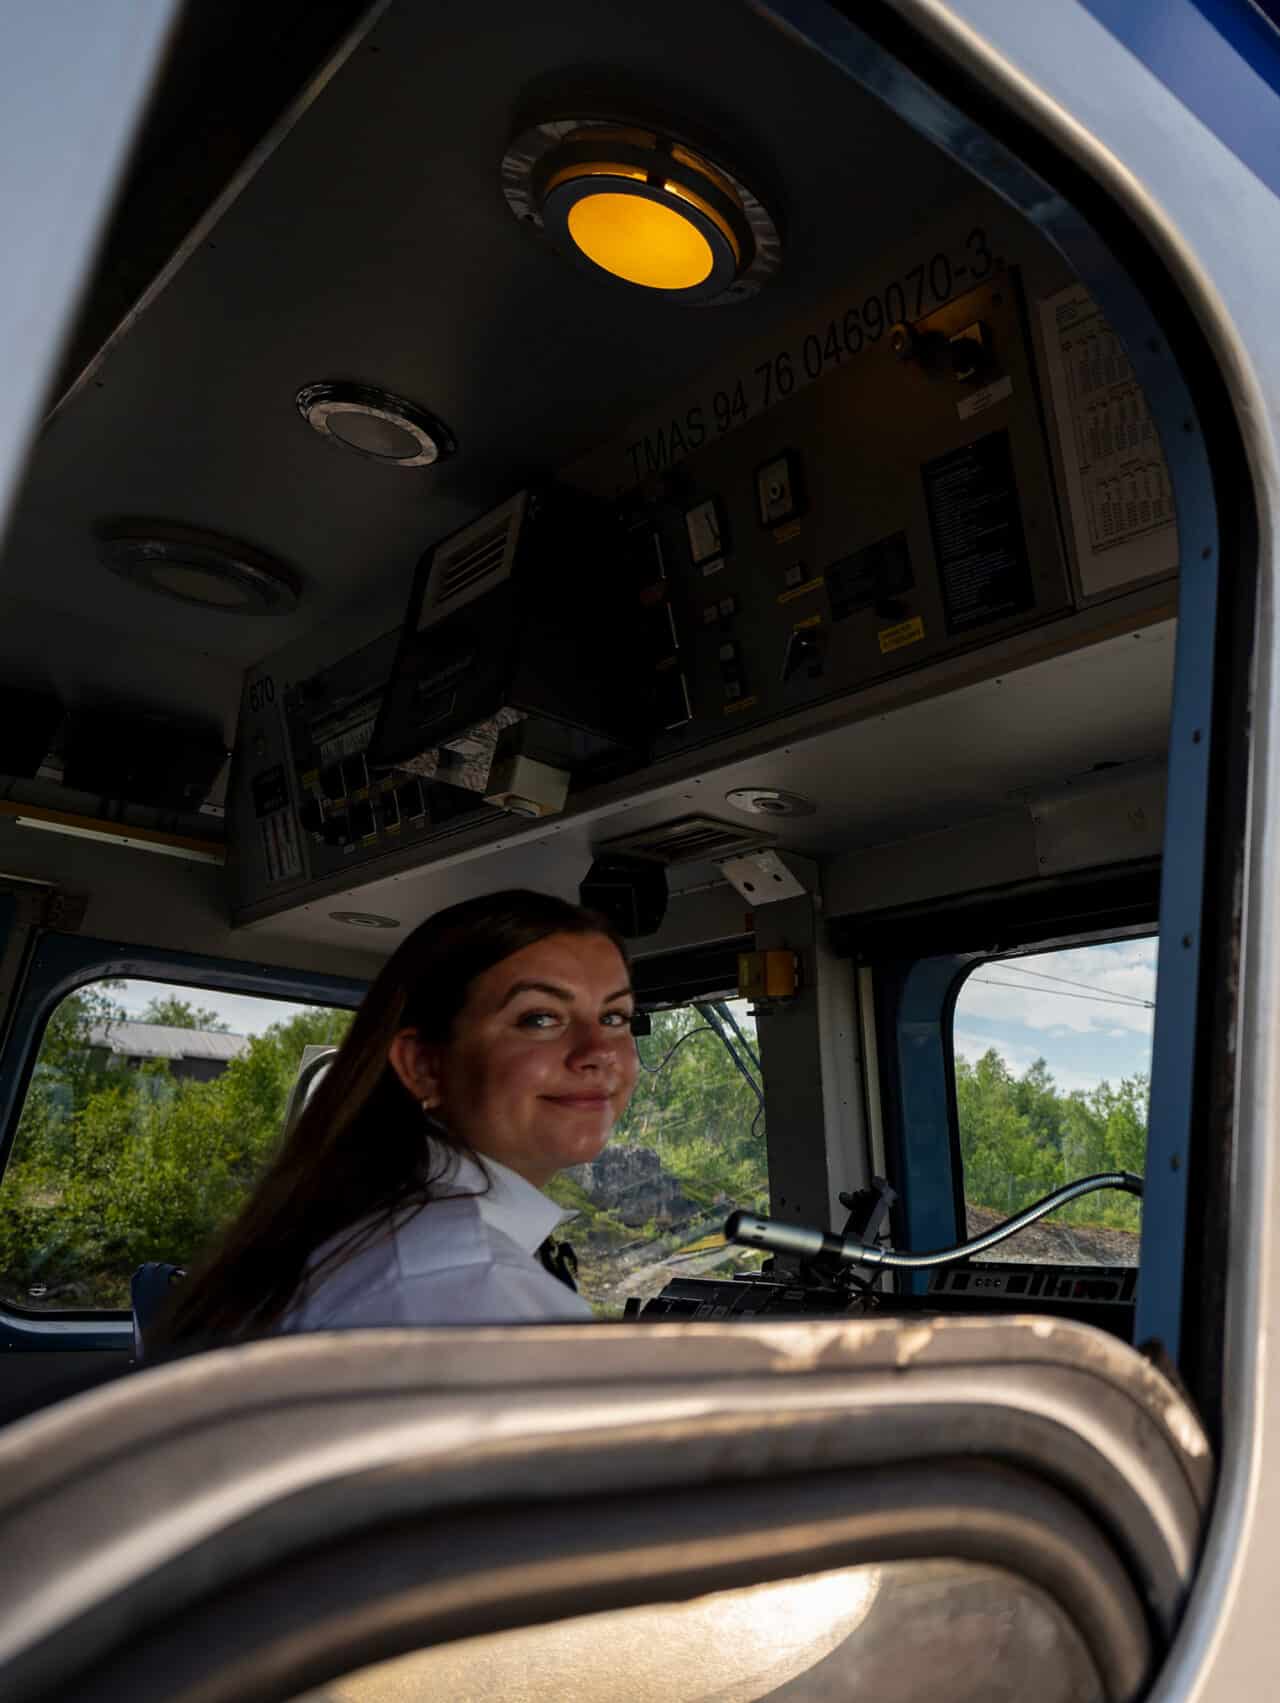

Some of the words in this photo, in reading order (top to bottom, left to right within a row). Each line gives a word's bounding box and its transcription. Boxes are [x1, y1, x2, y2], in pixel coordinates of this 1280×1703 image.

[626, 407, 705, 482] TMAS
[712, 376, 749, 432] 94
[753, 350, 795, 407] 76
[802, 228, 993, 378] 0469070-3
